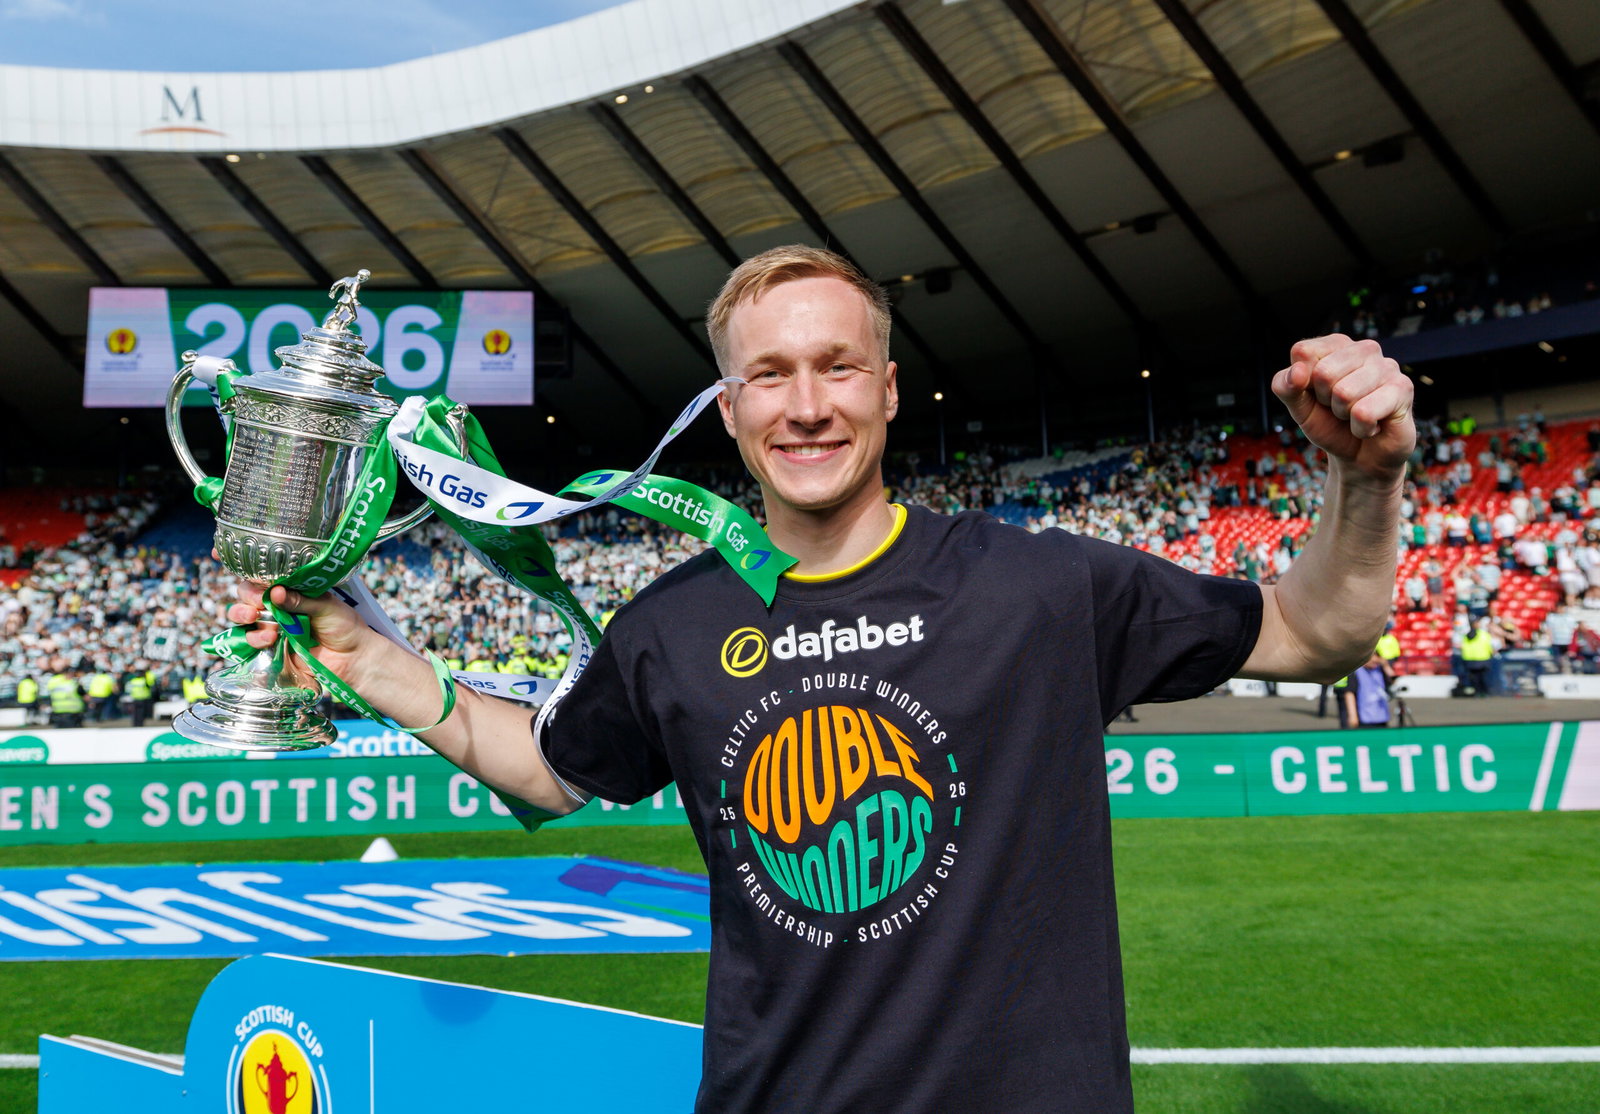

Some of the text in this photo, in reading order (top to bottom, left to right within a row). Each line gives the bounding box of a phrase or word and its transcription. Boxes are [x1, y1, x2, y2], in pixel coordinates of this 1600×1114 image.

[159, 85, 206, 122] M
[439, 474, 488, 508] Gas
[631, 480, 750, 552] Scottish Gas
[322, 472, 386, 573] Scottish
[483, 535, 517, 551] Gas
[772, 615, 924, 662] dafabet
[721, 709, 758, 768] CELTIC
[760, 690, 781, 712] FC
[802, 673, 869, 692] DOUBLE
[876, 680, 947, 744] WINNERS
[744, 705, 934, 844] DOUBLE
[950, 782, 966, 798] 26
[1270, 744, 1497, 794] CELTIC
[141, 775, 416, 828] SCOTTISH
[720, 806, 736, 821] 25
[747, 789, 933, 914] WINNERS
[197, 870, 692, 942] Gas
[737, 862, 833, 948] PREMIERSHIP
[858, 884, 938, 942] SCOTTISH
[936, 842, 958, 879] CUP
[235, 1005, 323, 1057] SCOTTISH CUP
